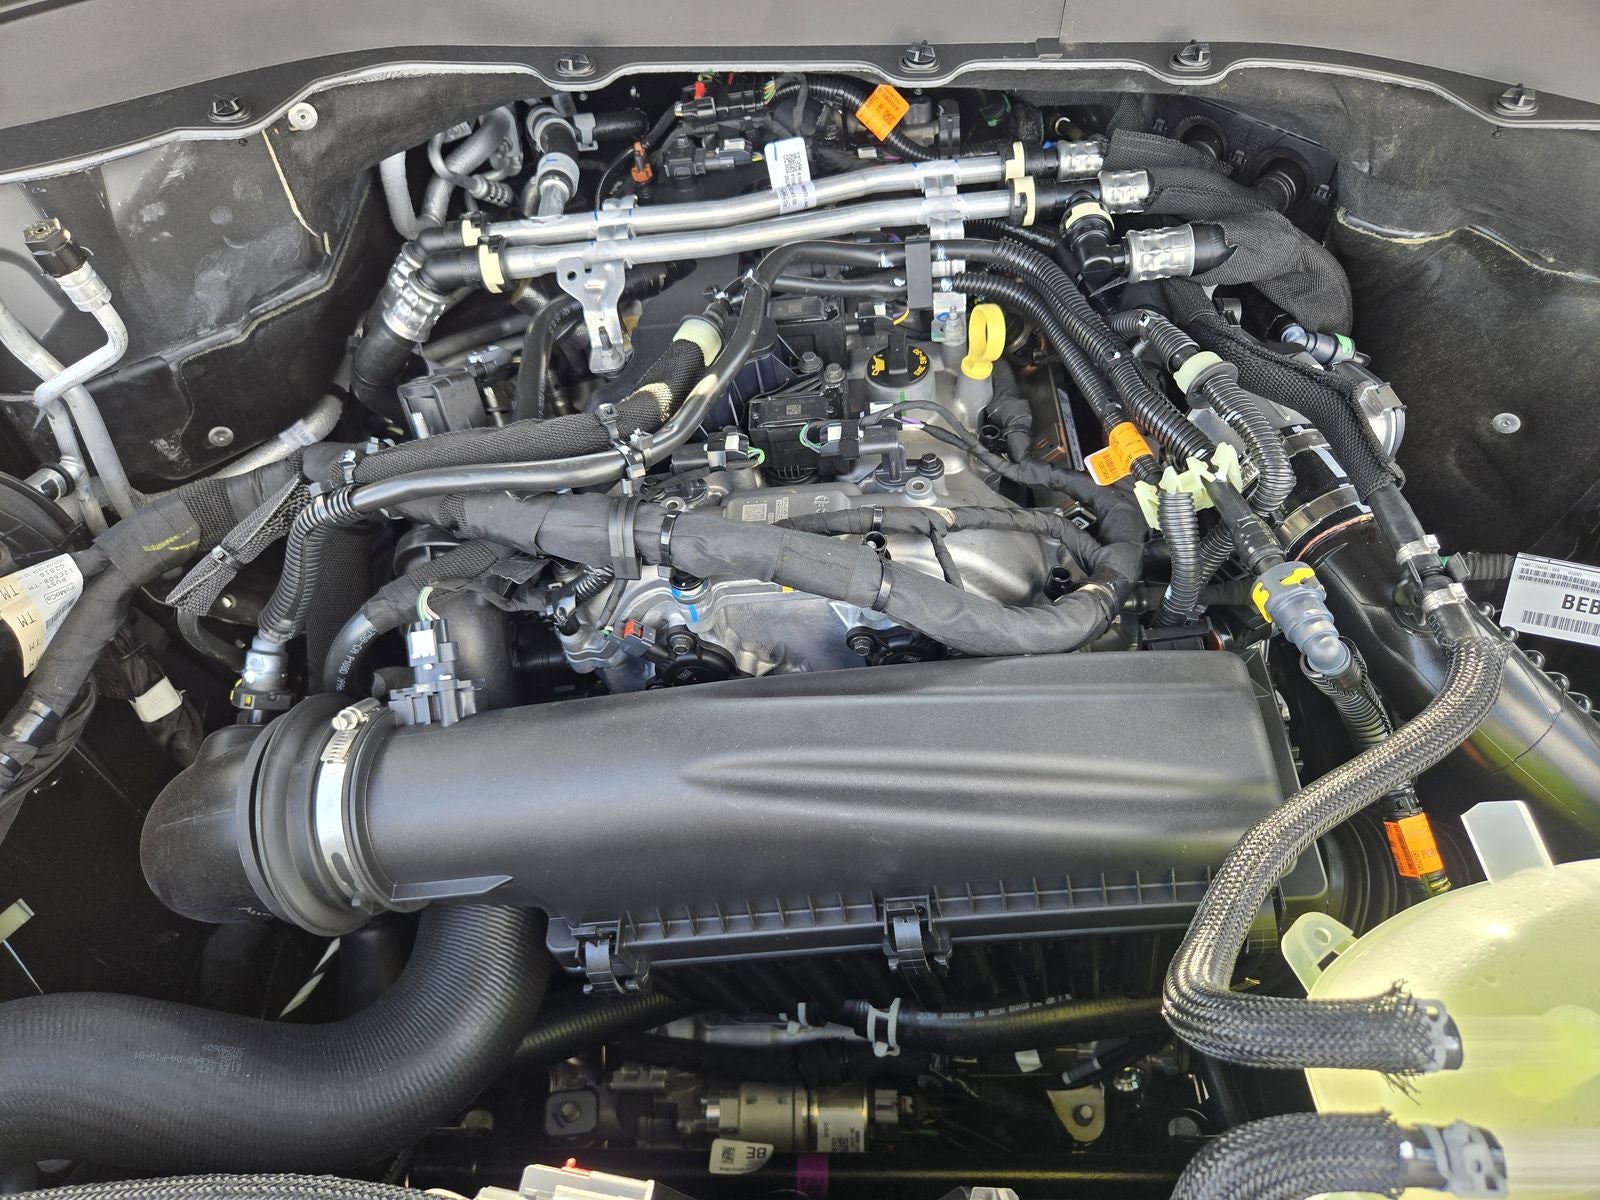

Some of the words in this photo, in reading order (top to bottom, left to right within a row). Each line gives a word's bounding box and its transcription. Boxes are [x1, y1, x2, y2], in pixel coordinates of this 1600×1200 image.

[0, 584, 20, 600] TM
[1561, 594, 1600, 615] BEB
[17, 611, 36, 628] TM
